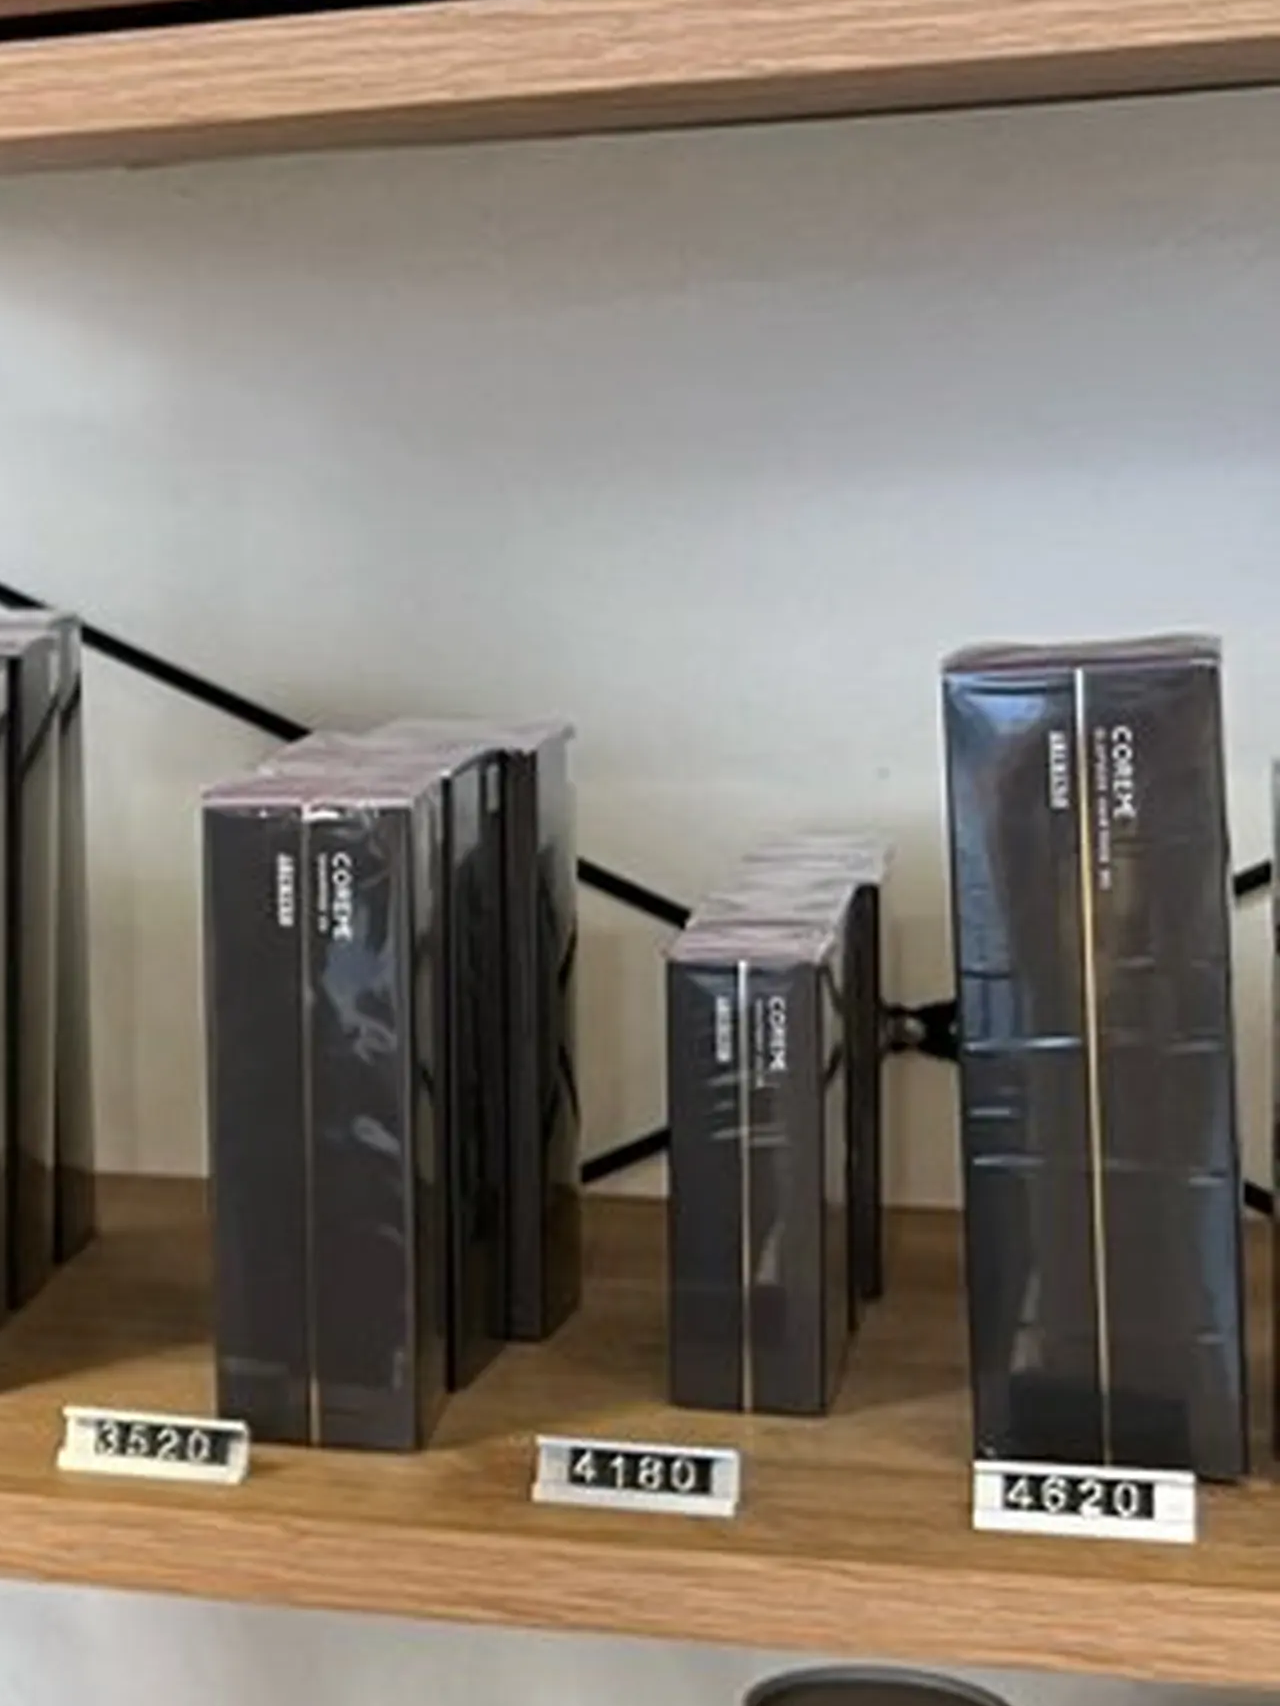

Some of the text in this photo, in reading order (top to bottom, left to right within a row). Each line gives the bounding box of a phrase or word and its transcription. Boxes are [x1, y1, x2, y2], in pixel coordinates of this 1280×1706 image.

[95, 1419, 211, 1462] 3520
[572, 1450, 697, 1492] 4180
[1006, 1476, 1139, 1519] 4620
